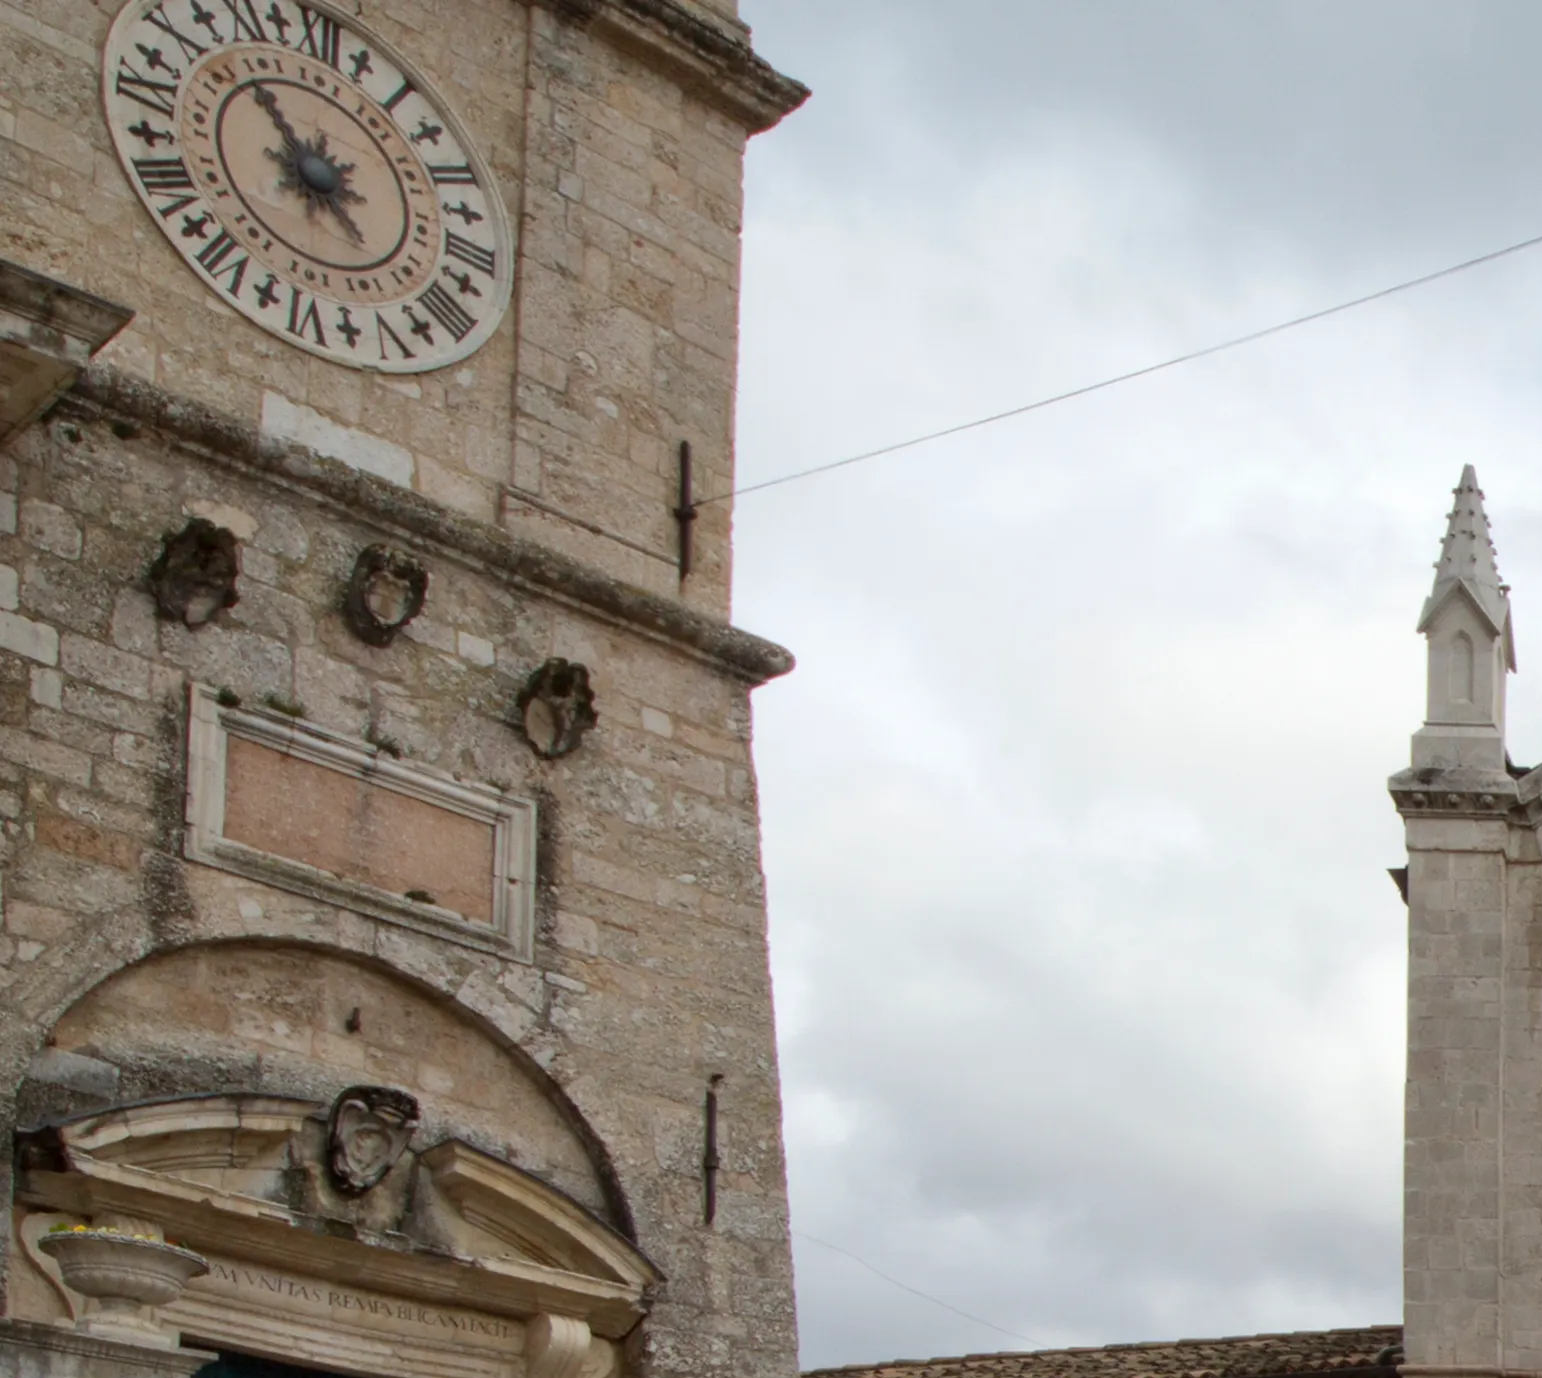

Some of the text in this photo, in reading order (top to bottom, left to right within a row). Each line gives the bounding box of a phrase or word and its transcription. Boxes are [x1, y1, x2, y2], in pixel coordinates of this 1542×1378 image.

[142, 3, 209, 66] X
[296, 5, 342, 73] XII
[116, 55, 178, 121] IX
[130, 156, 201, 224] VIII
[425, 161, 482, 190] II
[193, 226, 252, 300] VII
[444, 227, 496, 280] III
[285, 285, 330, 349] VI
[375, 309, 417, 361] V
